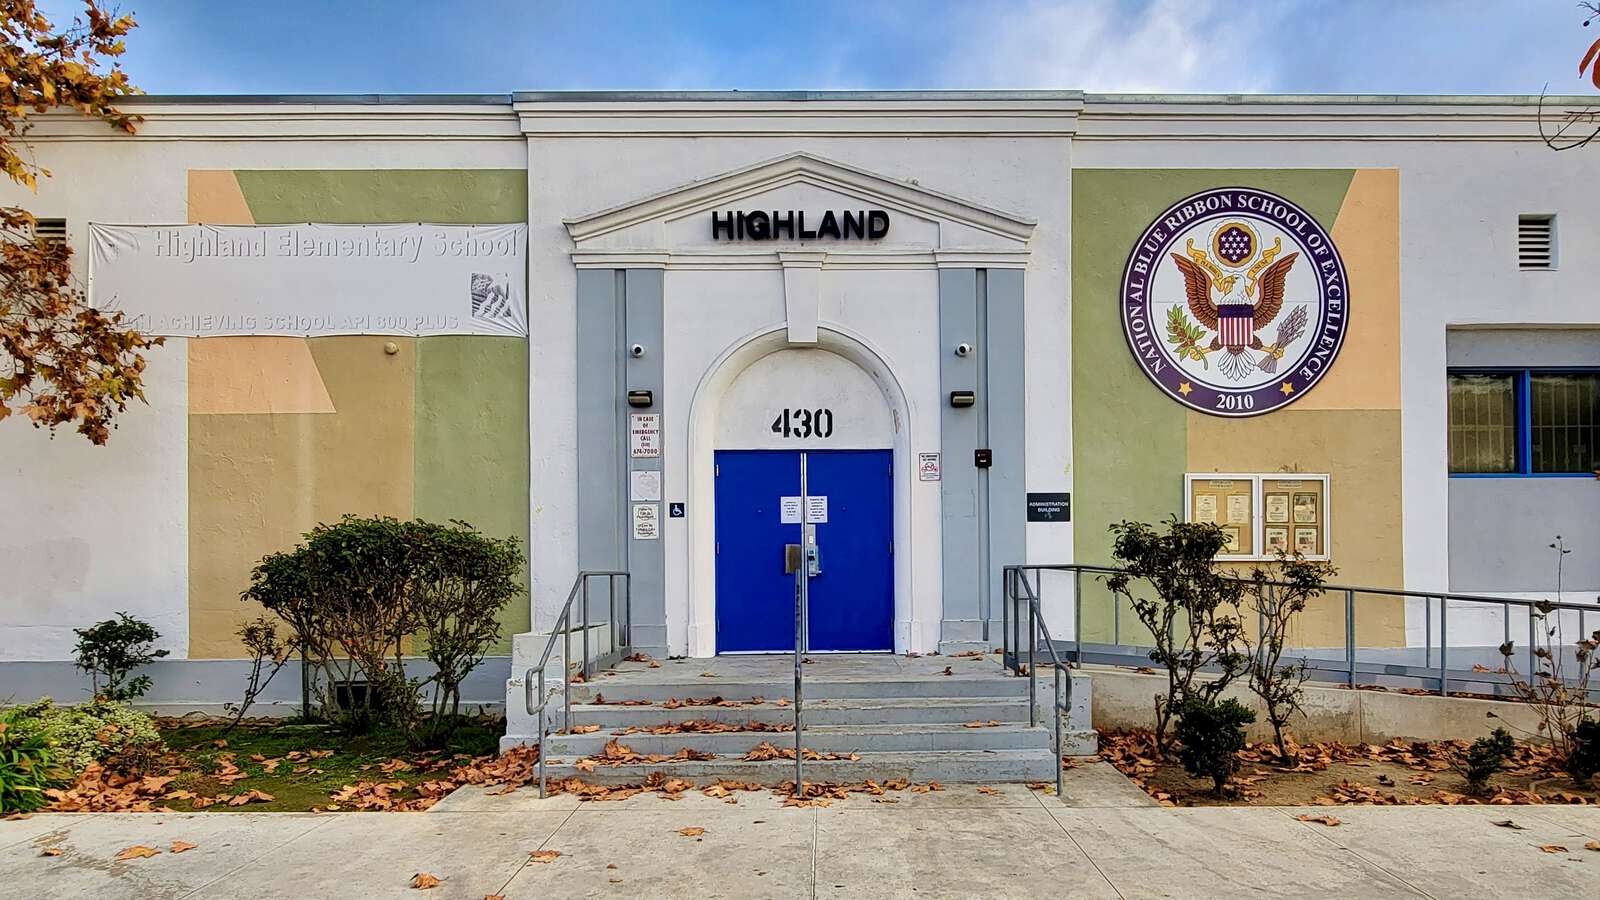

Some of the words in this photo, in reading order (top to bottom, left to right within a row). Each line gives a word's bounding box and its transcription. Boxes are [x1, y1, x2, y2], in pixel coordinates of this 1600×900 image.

[711, 209, 891, 240] HIGHLAND
[1165, 194, 1232, 232] RIBBON
[1237, 194, 1307, 236] SCHOOL
[153, 229, 267, 263] Highland
[279, 230, 423, 263] Elementary
[433, 229, 519, 257] School
[1134, 231, 1168, 276] BLUE
[1307, 233, 1328, 258] OF
[160, 313, 257, 331] ACHIEVING
[263, 313, 335, 331] SCHOOL
[376, 313, 408, 330] 800
[414, 313, 460, 330] PLUS
[1130, 276, 1167, 374] NATIONAL
[1299, 258, 1342, 381] EXCELLENCE
[1216, 393, 1254, 410] 2010
[771, 408, 833, 438] 430
